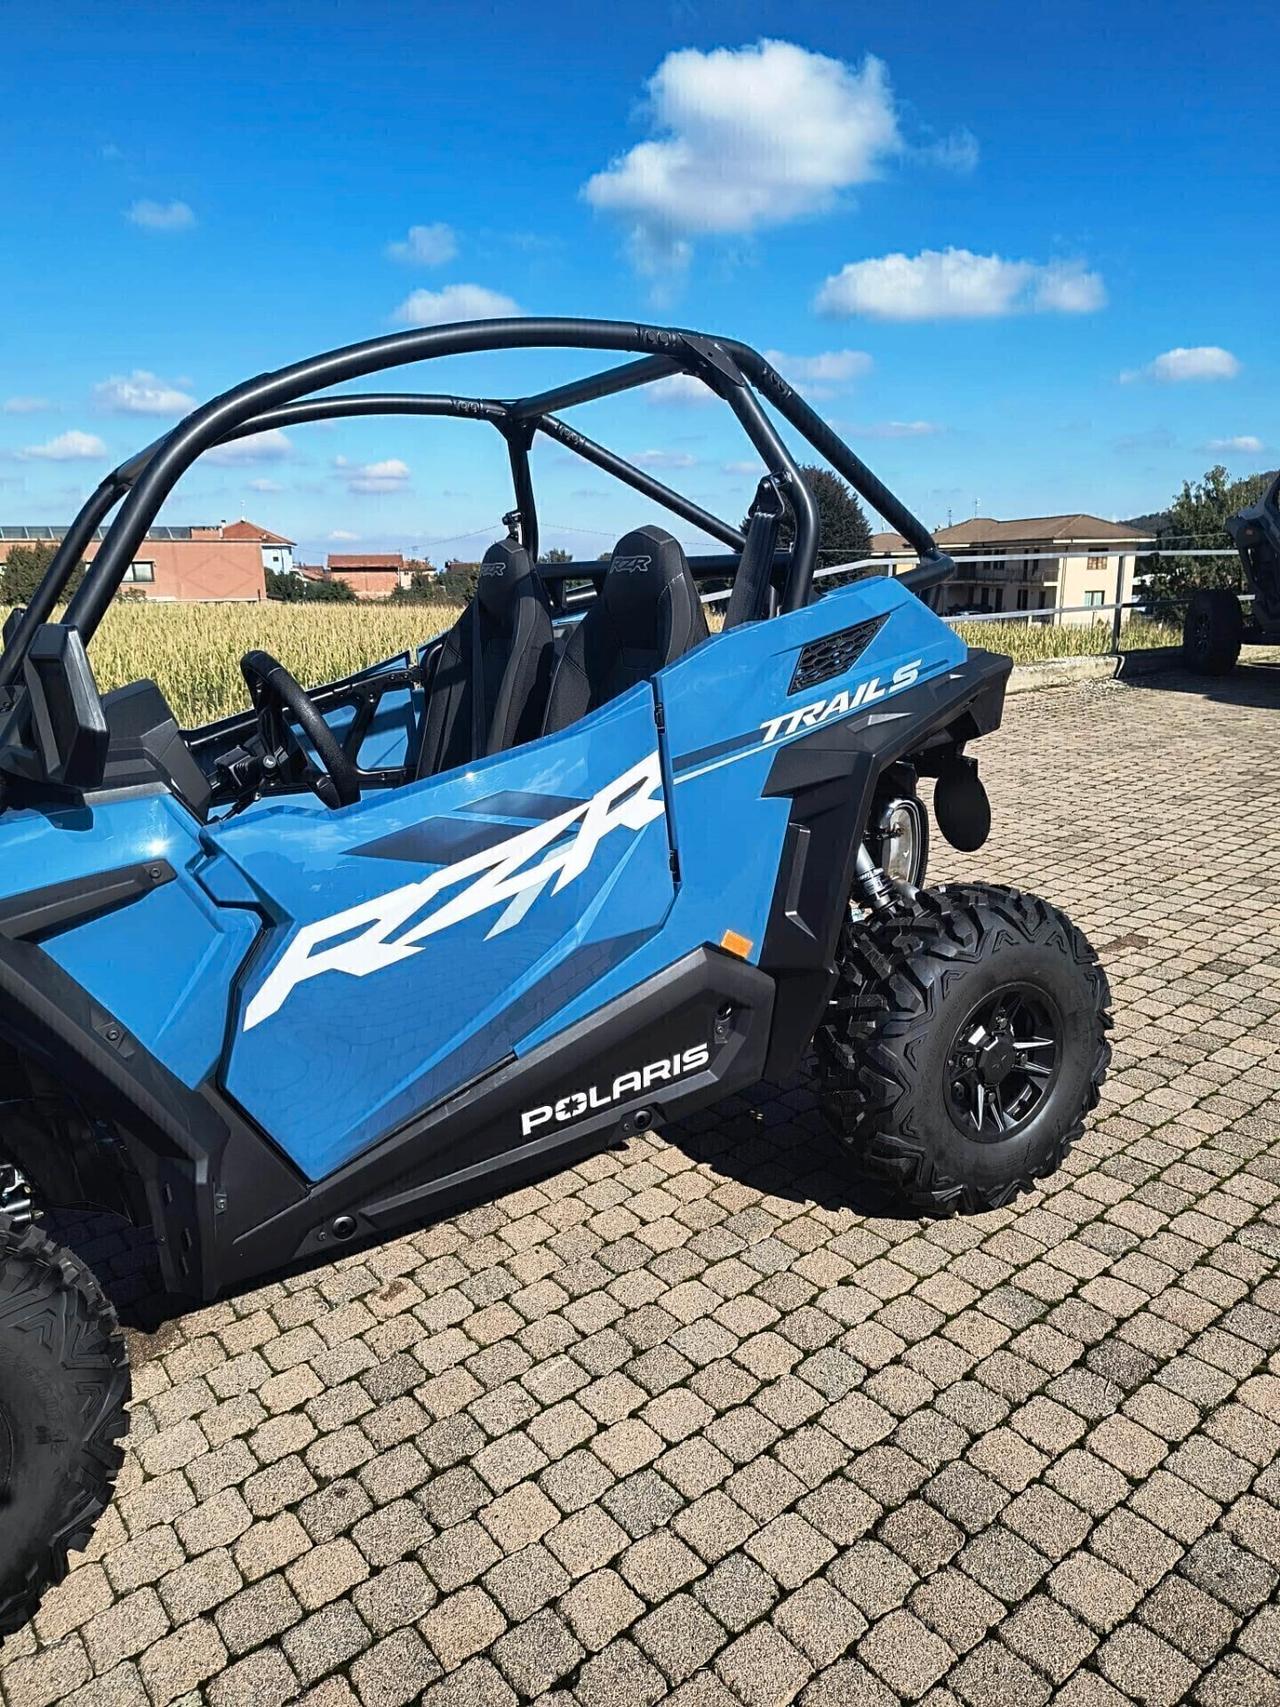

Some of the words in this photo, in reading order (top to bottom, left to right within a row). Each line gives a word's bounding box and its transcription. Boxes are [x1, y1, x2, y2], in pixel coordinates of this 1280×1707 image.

[610, 555, 652, 575] RZR
[759, 658, 922, 744] TRAILS
[243, 750, 666, 1032] RZR
[521, 1042, 709, 1136] POLARIS
